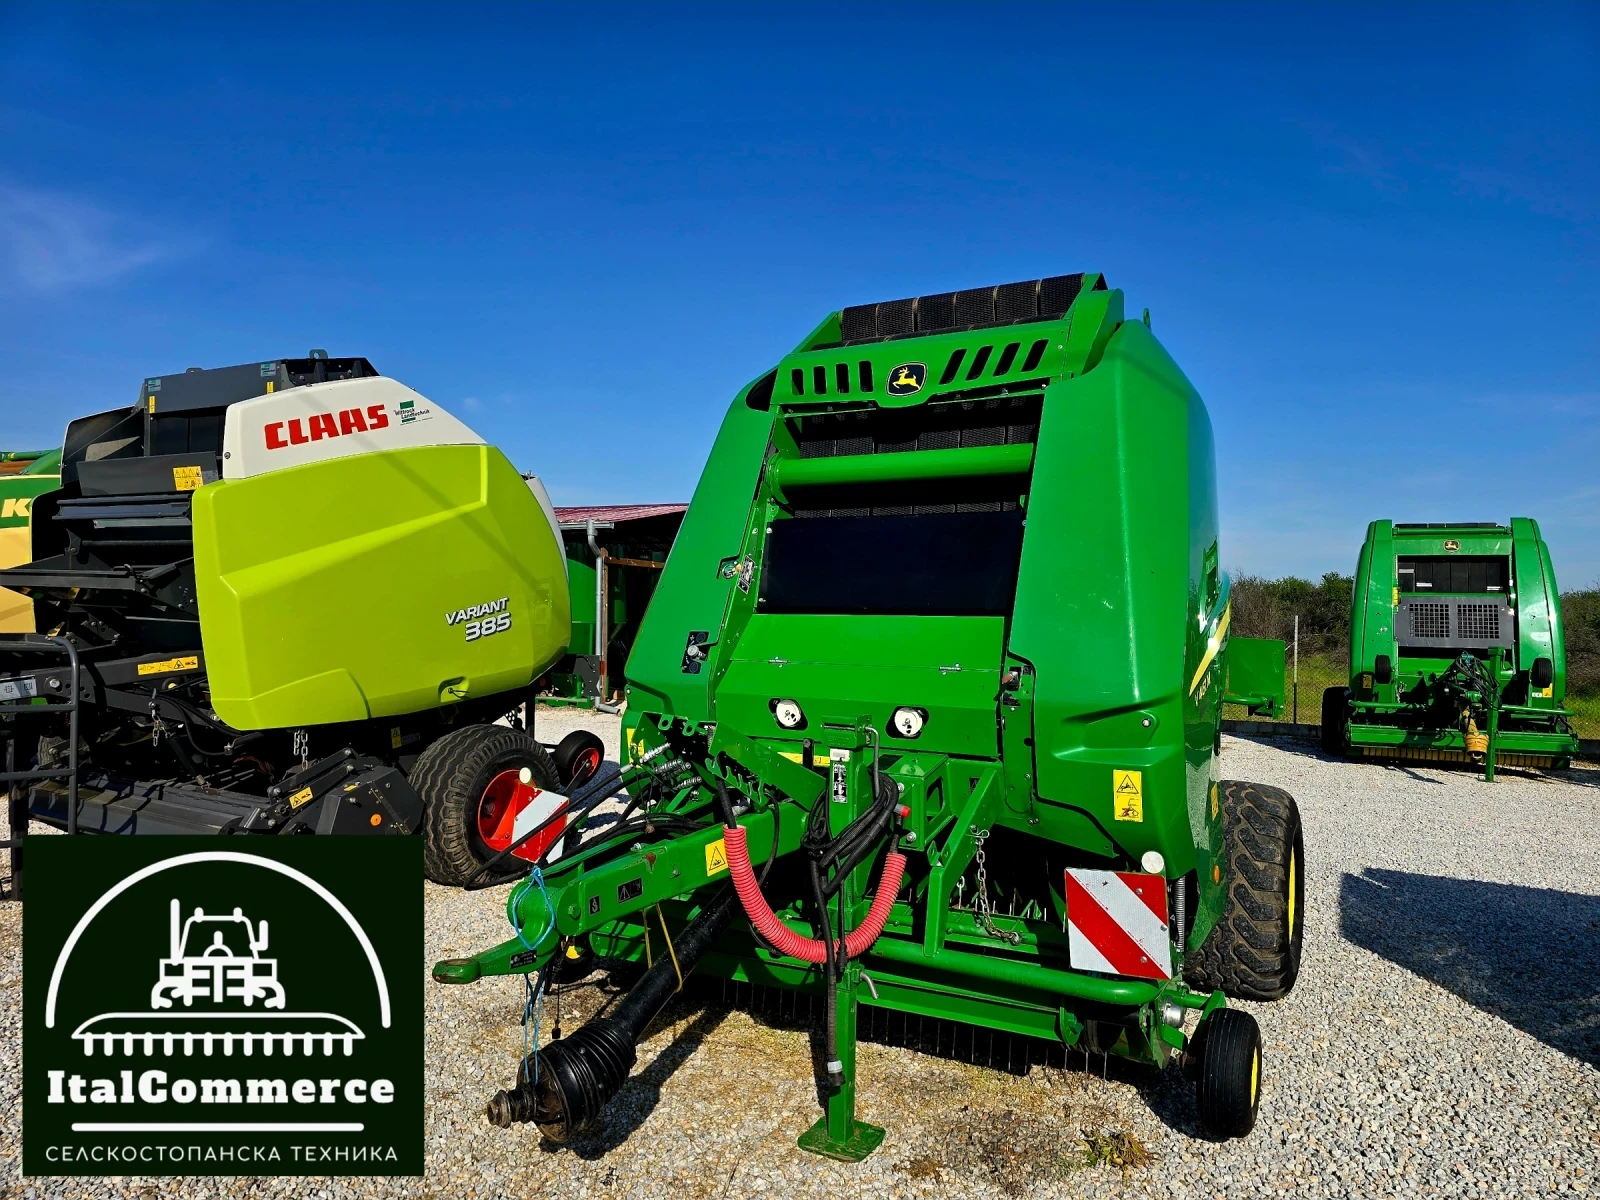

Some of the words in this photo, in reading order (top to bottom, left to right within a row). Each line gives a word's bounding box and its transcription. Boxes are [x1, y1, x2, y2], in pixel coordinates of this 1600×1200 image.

[264, 404, 389, 449] CLAAS
[445, 597, 509, 626] VARIANT
[465, 612, 512, 642] 385
